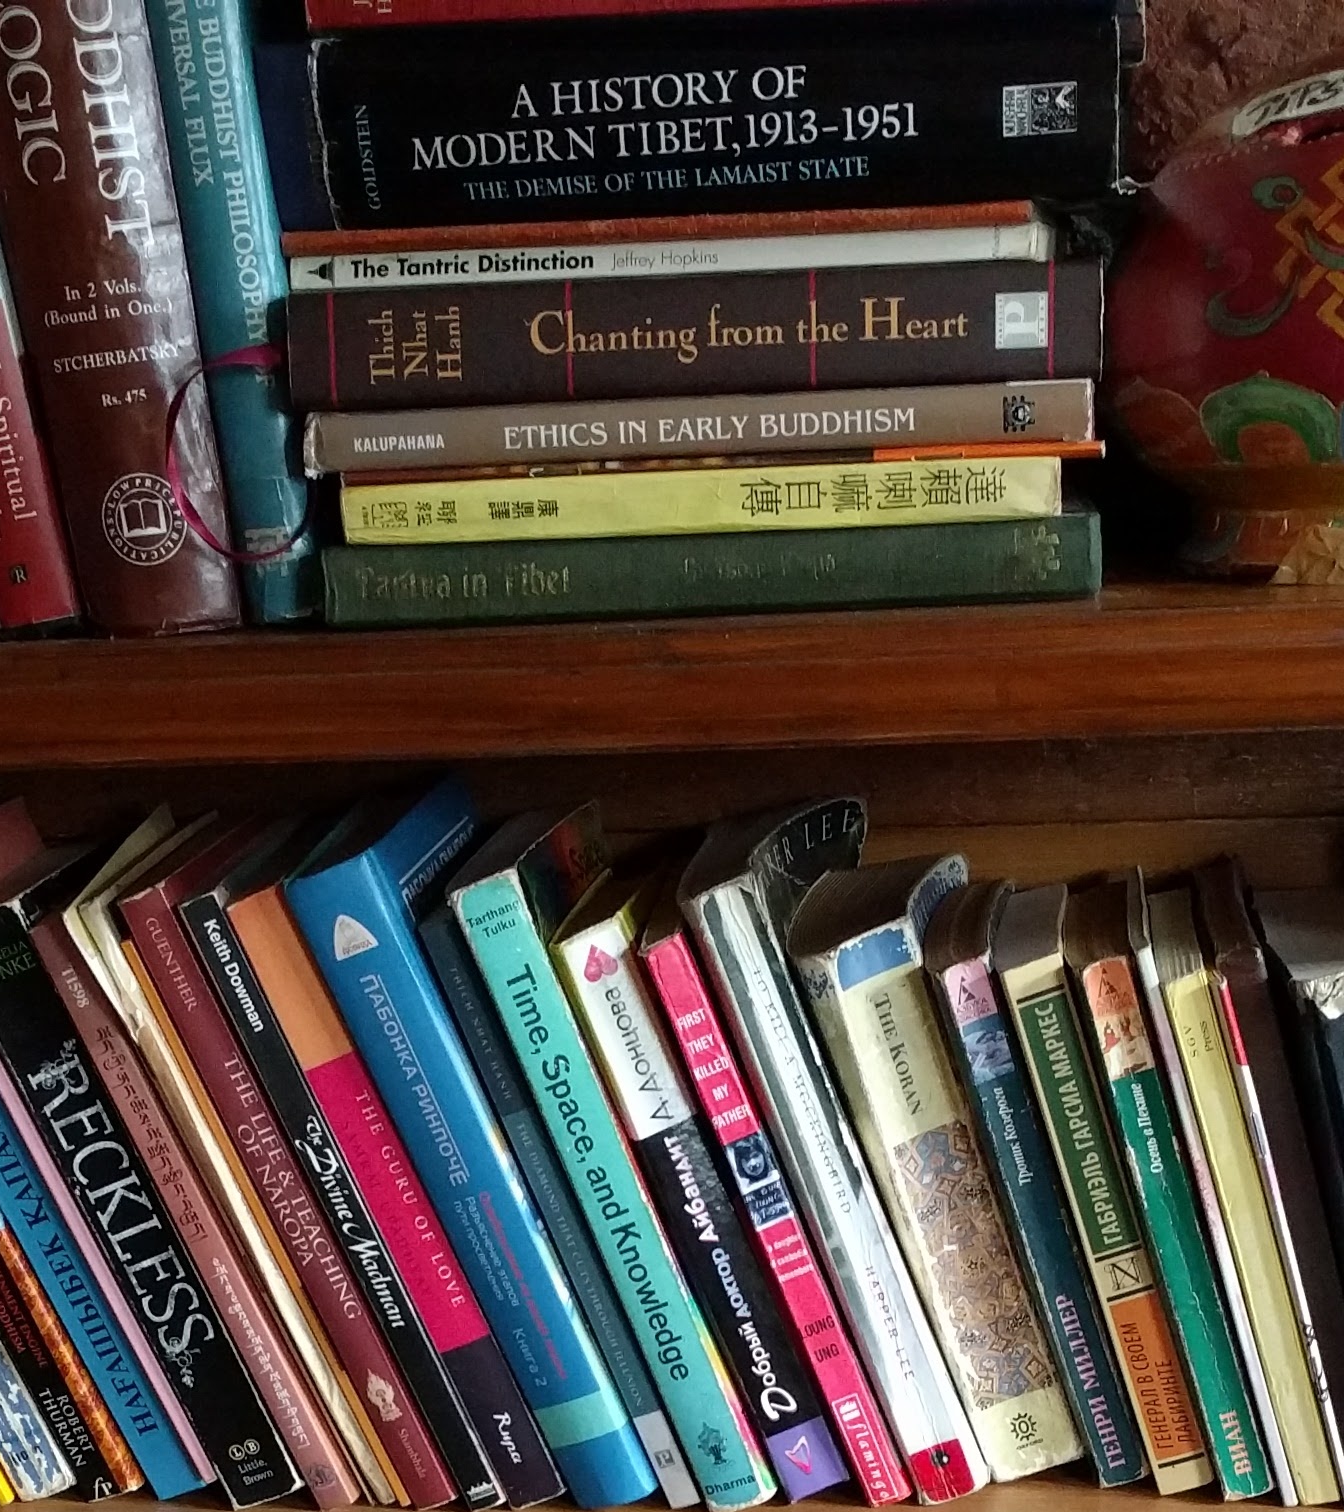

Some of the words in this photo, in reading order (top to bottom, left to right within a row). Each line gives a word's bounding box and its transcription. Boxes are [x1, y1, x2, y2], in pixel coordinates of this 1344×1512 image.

[511, 83, 541, 120] A
[551, 72, 743, 117] HISTORY
[752, 65, 807, 102] OF
[358, 103, 383, 210] GOLDSTEIN
[411, 125, 597, 173] MODERN
[464, 178, 510, 202] THE
[515, 172, 600, 198] DEMISE
[606, 170, 636, 192] OF
[641, 167, 689, 191] THE
[694, 160, 793, 188] LAMAIST
[797, 155, 871, 182] STATE
[350, 257, 390, 279] The
[397, 253, 471, 276] Tantric
[478, 249, 595, 274] Distinction
[609, 251, 656, 273] Jeffrey
[660, 249, 720, 271] Hopkins
[369, 309, 398, 385] Thich
[404, 311, 430, 378] Nhat
[437, 305, 463, 382] Hanh
[529, 309, 699, 363] Chanting
[706, 314, 785, 349] from
[795, 305, 851, 344] the
[859, 295, 970, 342] Heart
[352, 433, 447, 453] KALUPAHANA
[504, 418, 610, 451] ETHICS
[616, 416, 649, 445] IN
[655, 412, 752, 443] EARLY
[759, 408, 918, 437] BUDDHISM
[740, 464, 1008, 518] 達賴喇嘛自傳
[146, 917, 197, 1013] GUENTHER
[203, 918, 229, 962] Keith
[224, 961, 264, 1033] Dowman
[871, 993, 899, 1040] THE
[890, 1039, 923, 1116] KORAN
[27, 1045, 214, 1357] RECKLESS
[506, 962, 550, 1056] Time,
[542, 1054, 595, 1163] Space,
[586, 1166, 630, 1222] and
[610, 1220, 690, 1382] Knowledge
[493, 1411, 522, 1465] Rupa
[705, 1475, 755, 1500] Dharma
